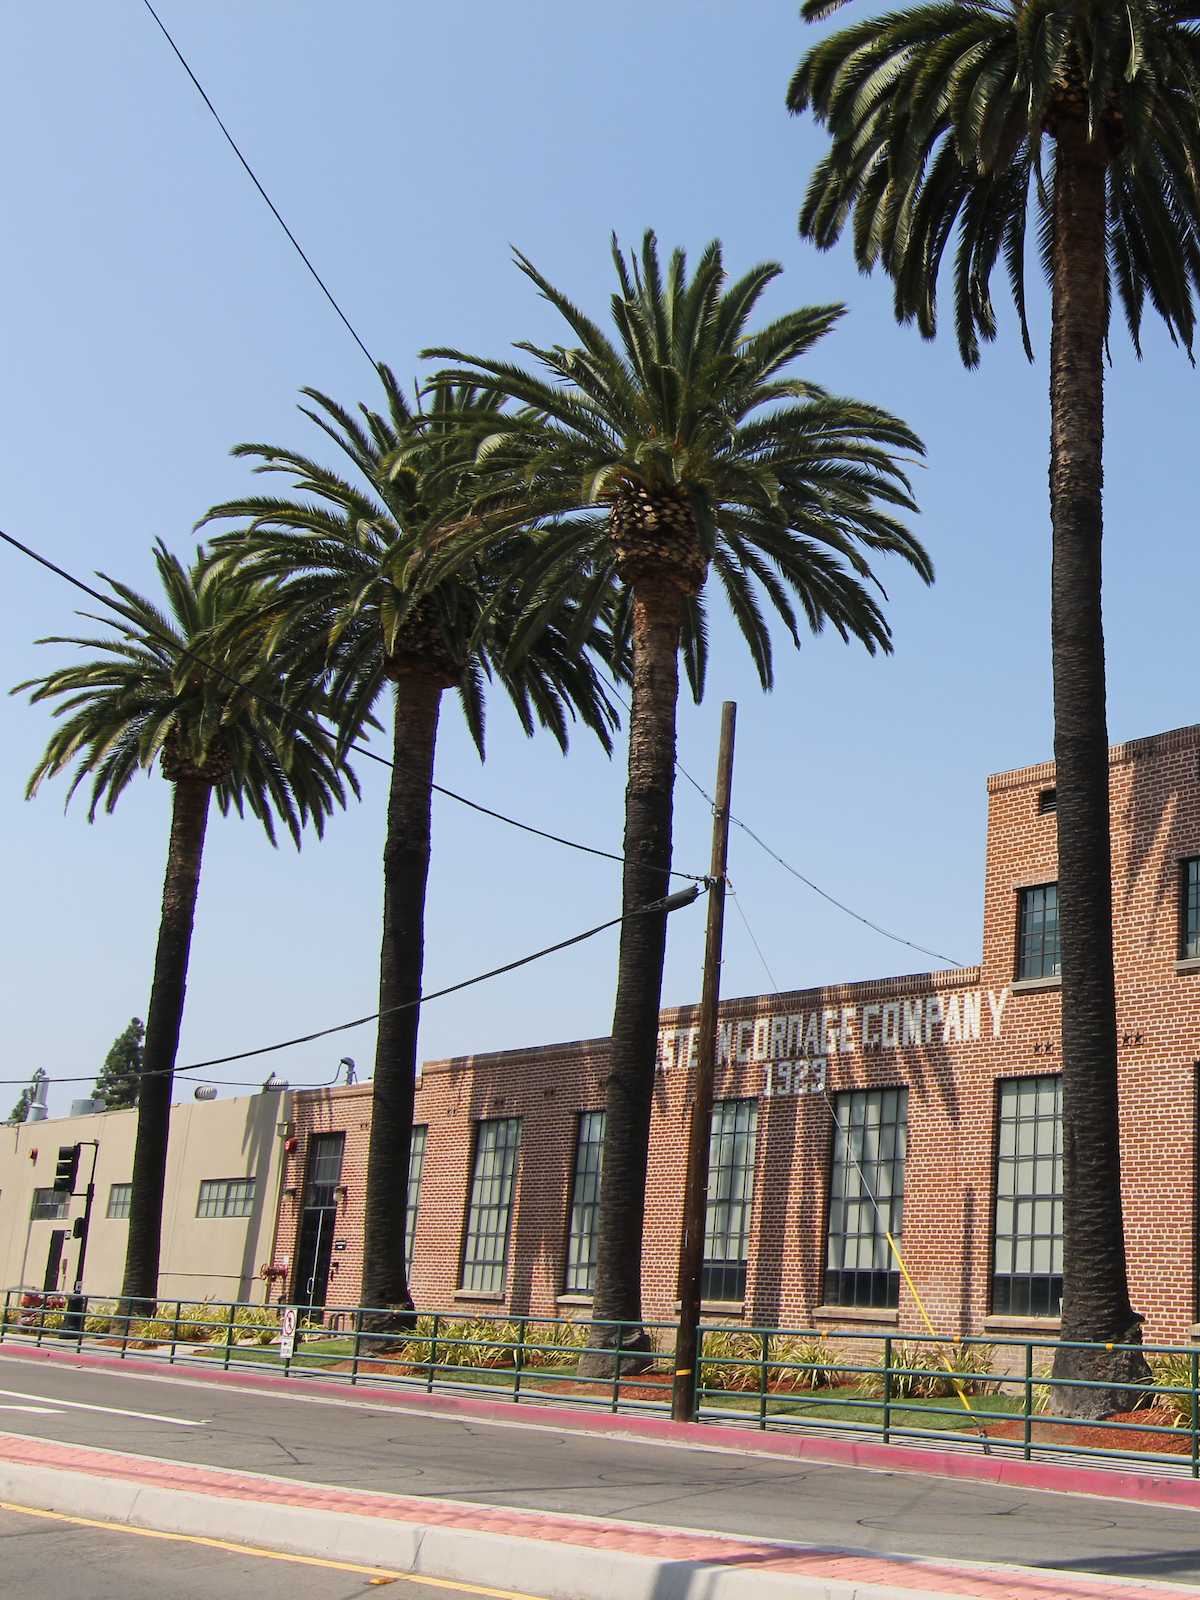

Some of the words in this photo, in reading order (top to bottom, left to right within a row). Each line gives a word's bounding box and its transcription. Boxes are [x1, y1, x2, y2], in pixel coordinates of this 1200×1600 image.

[736, 1007, 856, 1062] CORDAGE
[862, 988, 1010, 1048] COMPANY
[764, 1059, 827, 1096] 1923
